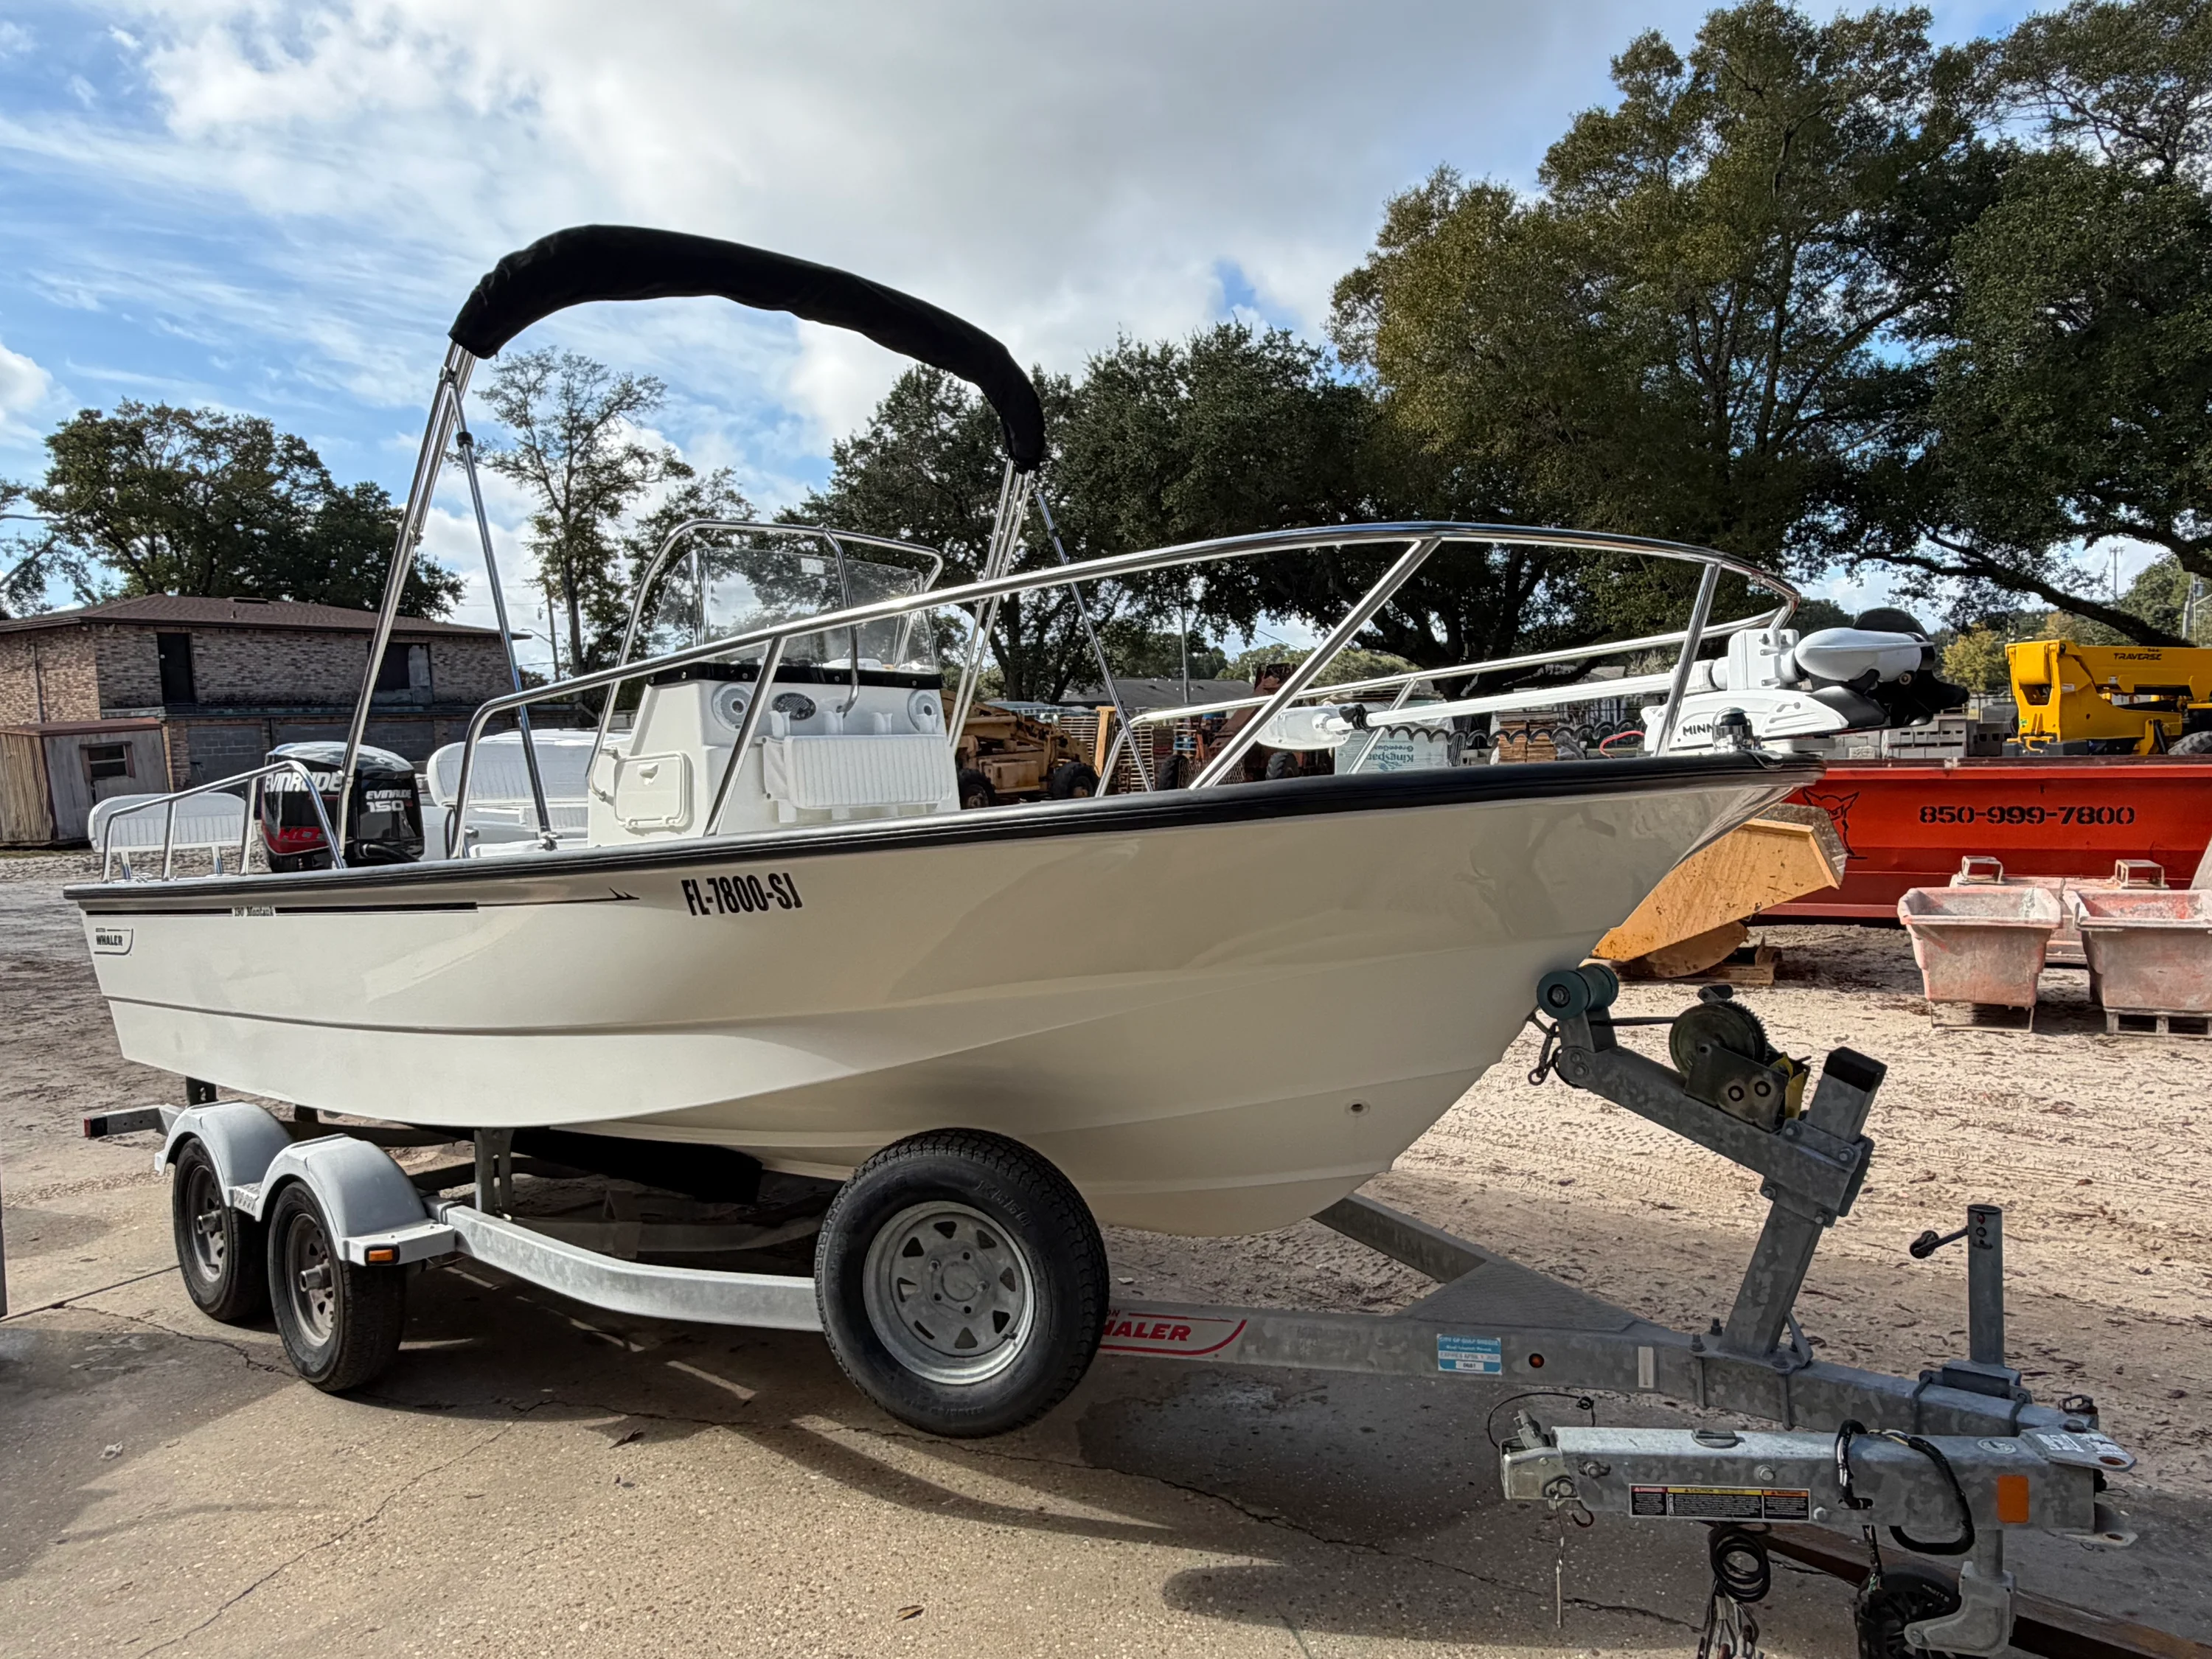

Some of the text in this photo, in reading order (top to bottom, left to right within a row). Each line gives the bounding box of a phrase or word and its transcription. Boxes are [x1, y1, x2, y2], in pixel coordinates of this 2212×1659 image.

[2113, 653, 2163, 661] TRAVERSE
[366, 789, 412, 800] EVINRUDE
[366, 799, 405, 813] 150
[1919, 805, 2135, 825] 850-999-7800
[681, 872, 803, 916] FL-7800-SJ
[96, 934, 123, 946] WHALER
